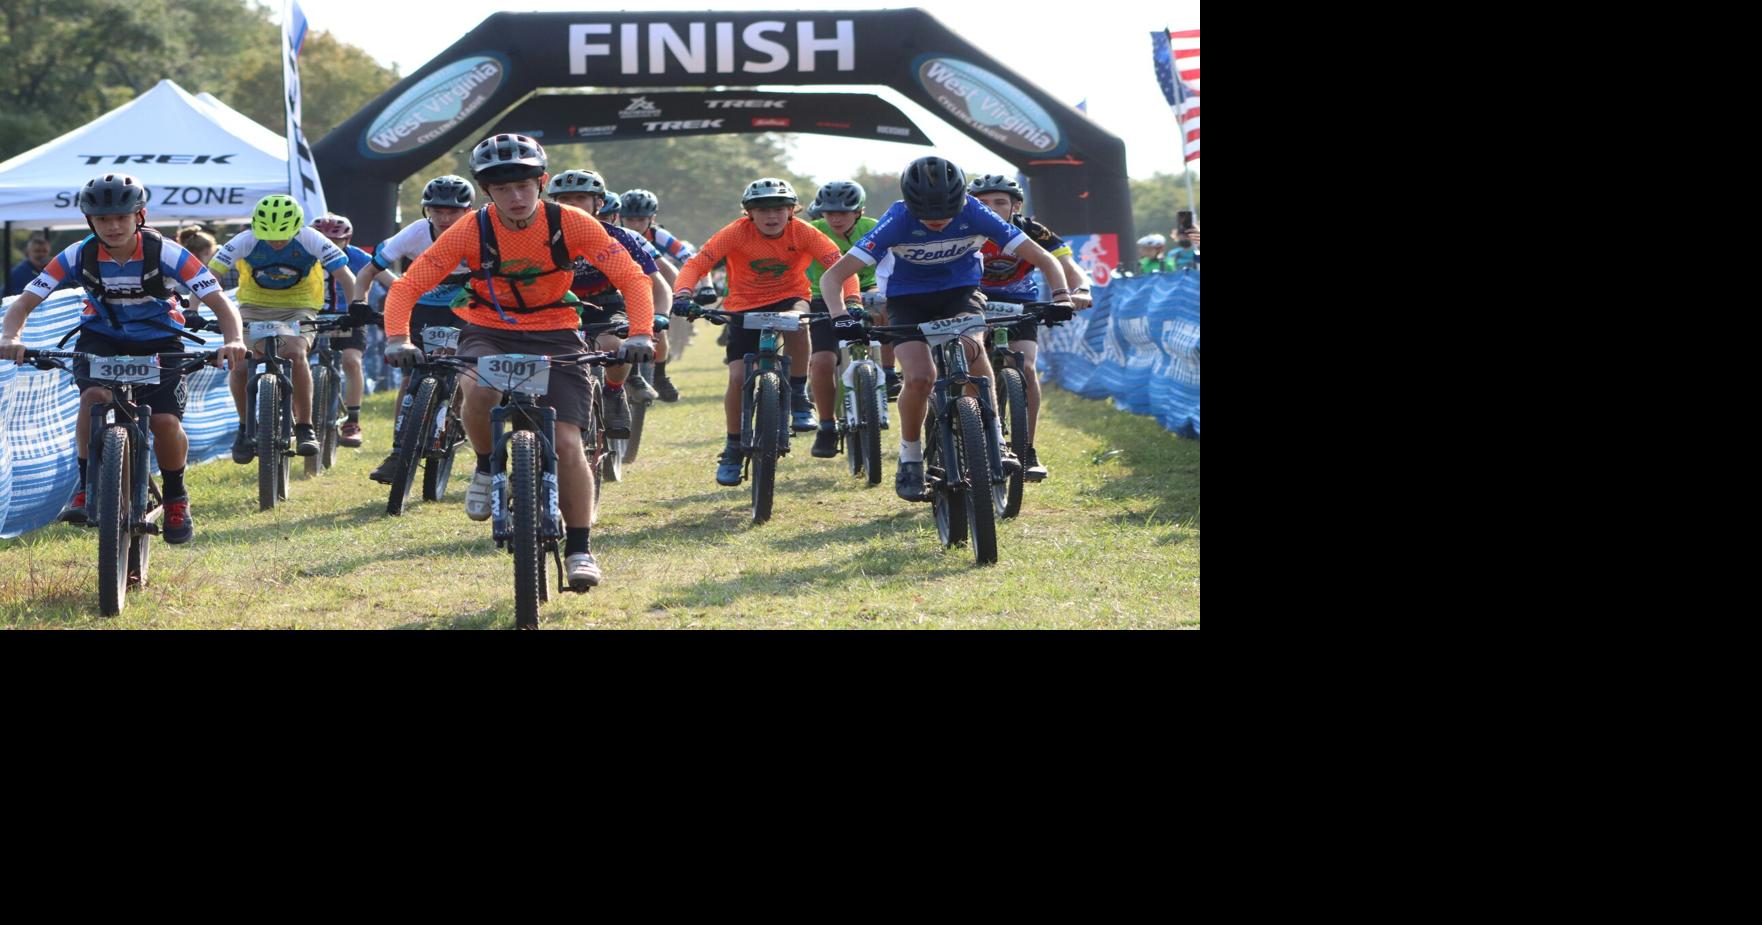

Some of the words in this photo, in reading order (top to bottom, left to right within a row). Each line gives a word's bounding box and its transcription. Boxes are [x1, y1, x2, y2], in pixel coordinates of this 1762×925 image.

[569, 20, 855, 75] FINISH
[371, 111, 428, 148] West
[425, 62, 499, 114] Virginia
[704, 100, 788, 109] TREK
[926, 61, 977, 101] West
[979, 95, 1051, 149] Virginia
[417, 117, 457, 144] CYCLING
[456, 94, 486, 122] LEAGUE
[643, 118, 726, 132] TREK
[937, 95, 972, 126] CYCLING
[972, 122, 1009, 143] LEAGUE
[78, 153, 238, 165] TREK
[161, 187, 246, 206] ZONE
[903, 240, 975, 261] Leader
[986, 303, 1015, 313] 033
[100, 363, 149, 377] 3000
[488, 359, 536, 377] 3001
